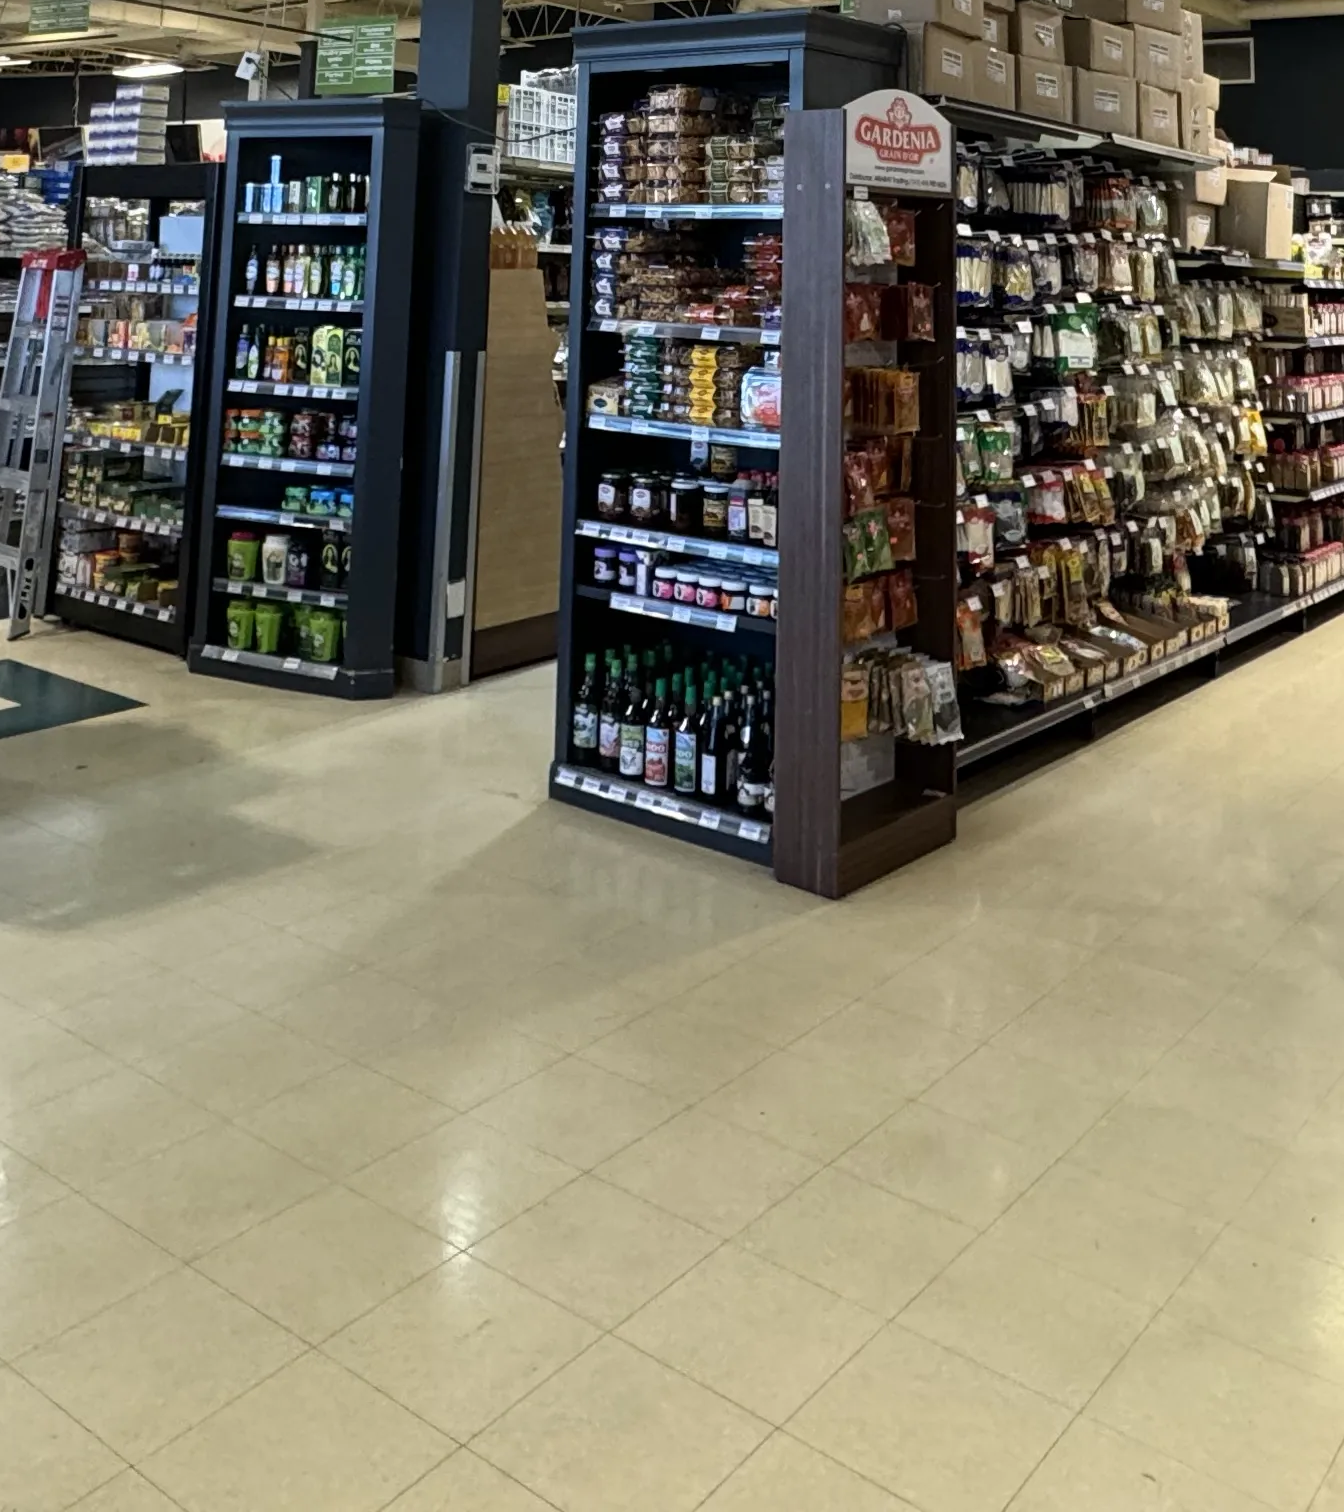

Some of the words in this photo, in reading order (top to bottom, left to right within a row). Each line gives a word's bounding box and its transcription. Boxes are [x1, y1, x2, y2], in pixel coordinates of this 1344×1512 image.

[860, 121, 936, 150] GARDENIA
[879, 148, 902, 159] GRAIN
[902, 152, 920, 162] D'OR
